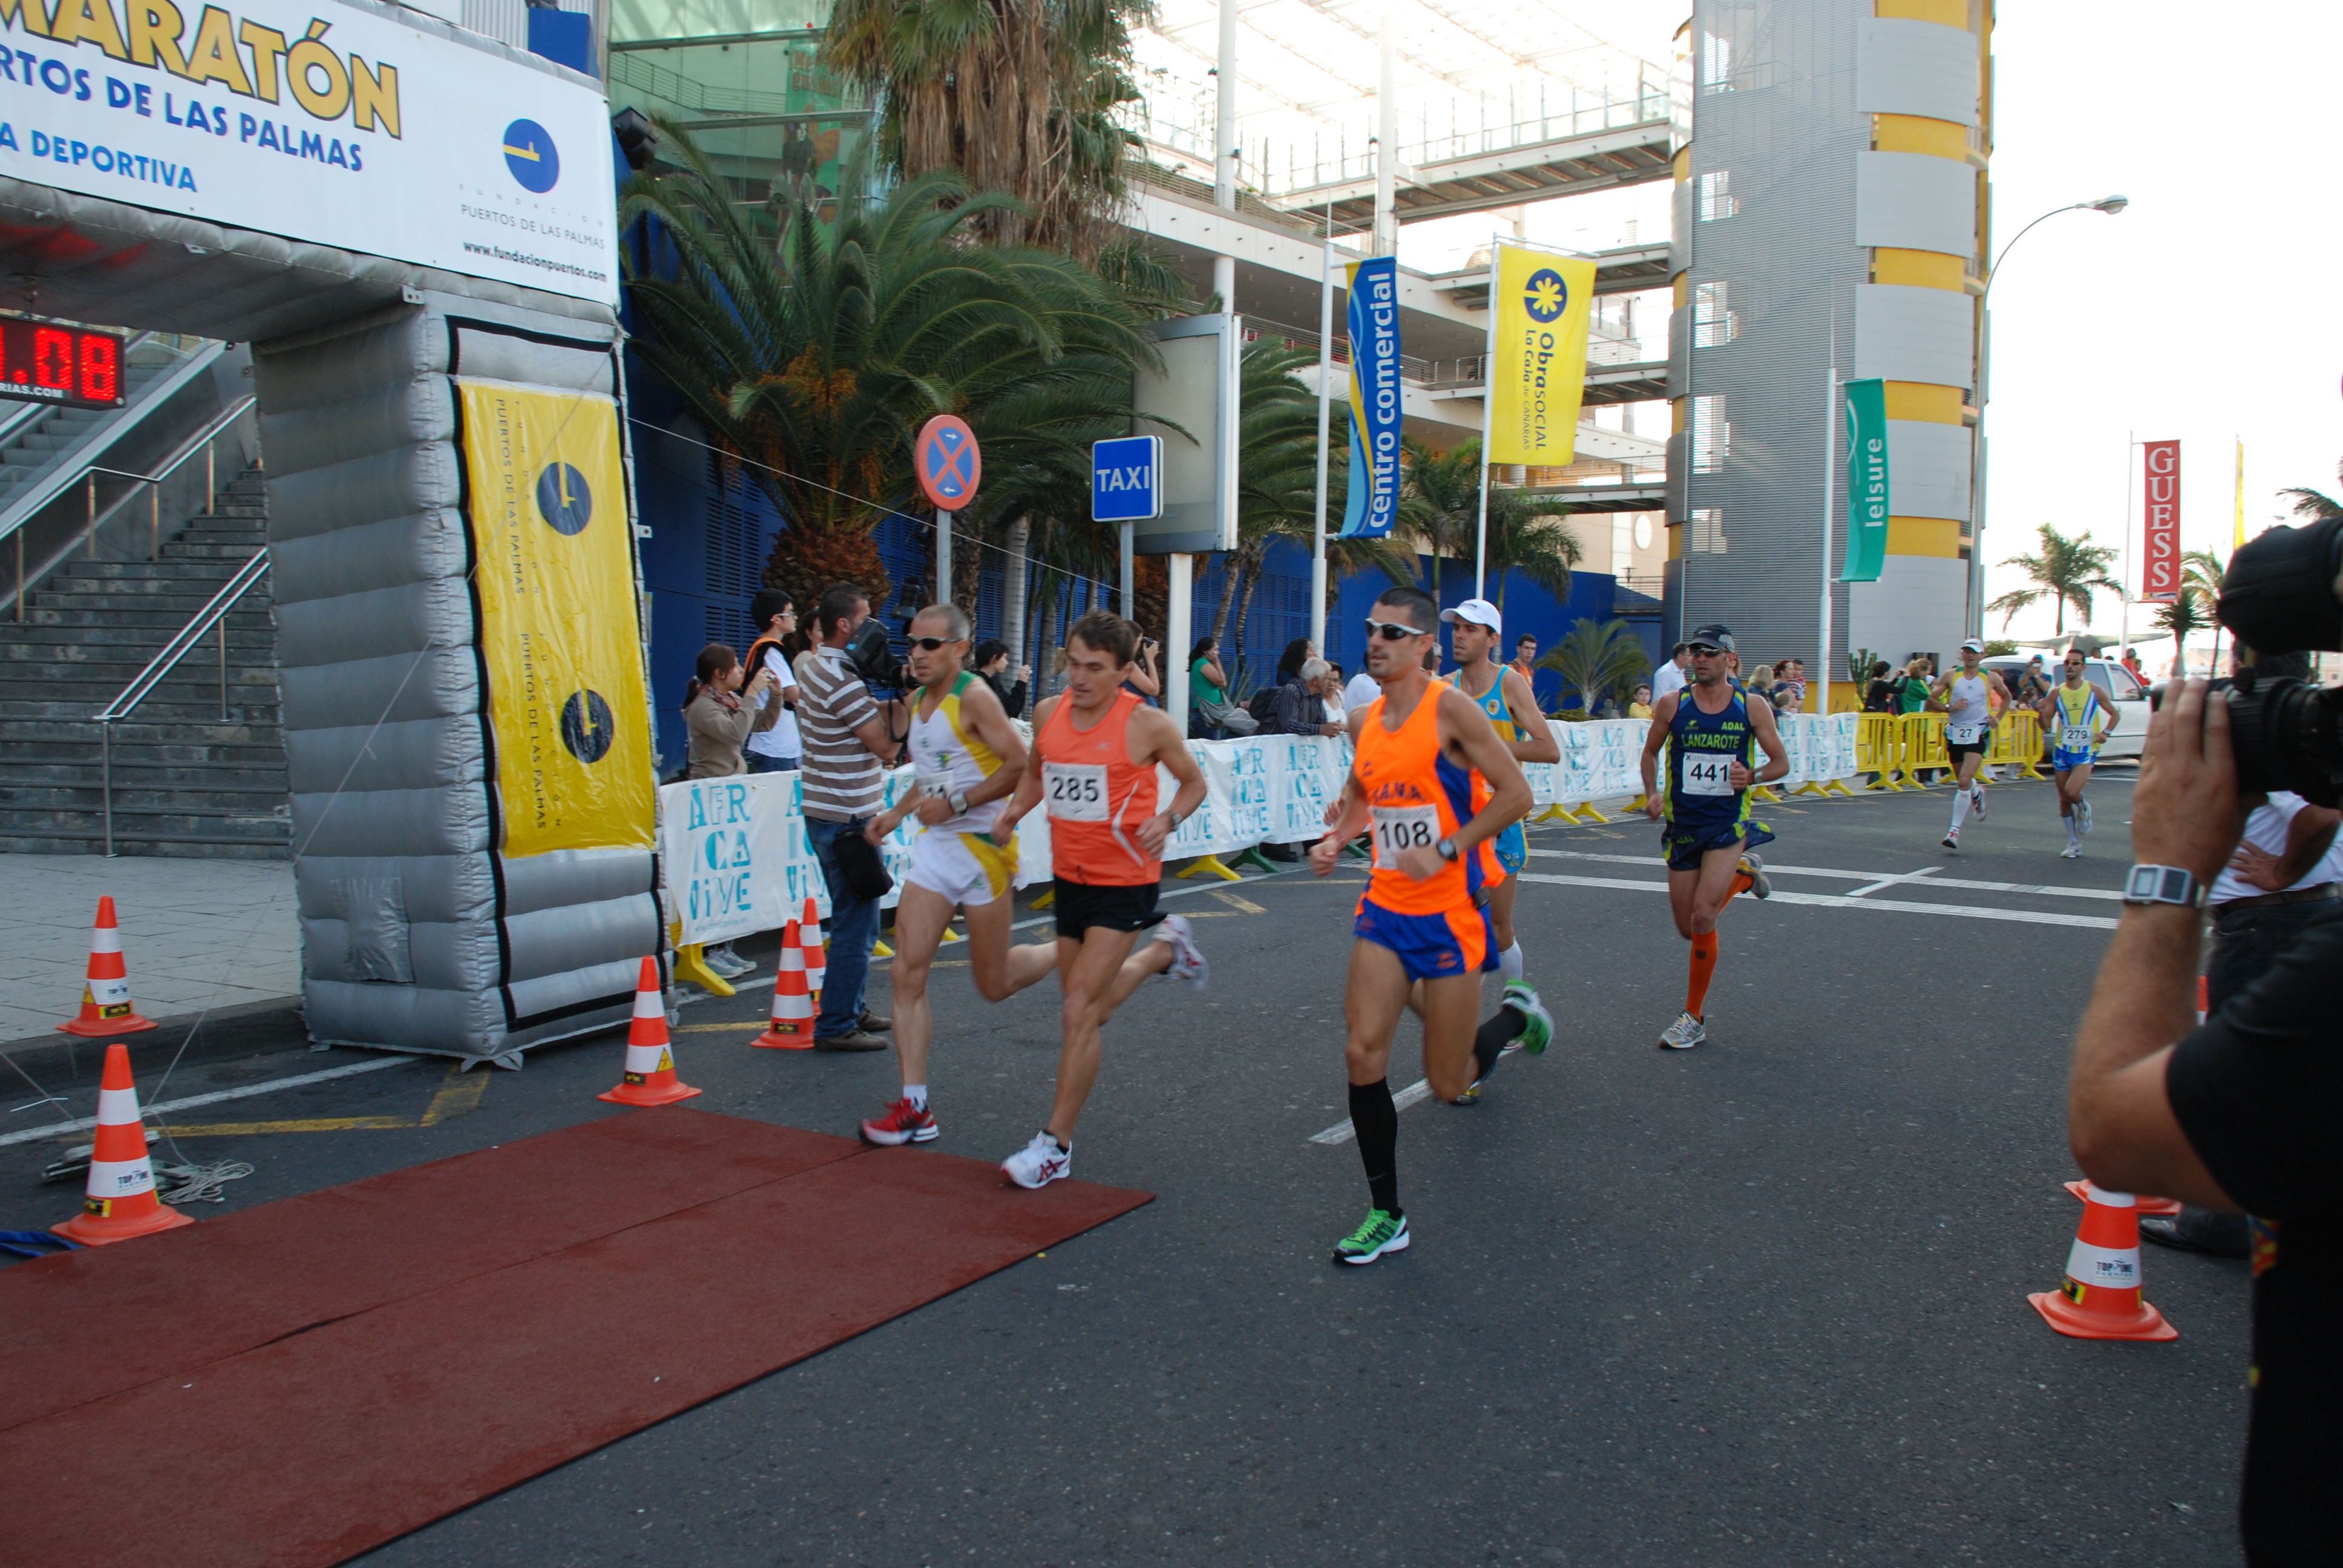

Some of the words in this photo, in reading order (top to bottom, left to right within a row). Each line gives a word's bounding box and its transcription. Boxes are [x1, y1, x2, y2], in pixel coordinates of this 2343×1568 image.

[106, 75, 152, 118] DE
[165, 92, 228, 136] LAS
[240, 112, 364, 172] PALMAS
[31, 129, 198, 193] DEPORTIVA
[460, 203, 517, 227] PUERTOS
[520, 218, 536, 232] DE
[540, 223, 562, 238] LAS
[564, 229, 605, 250] PALMAS
[462, 241, 608, 283] www.fundacionpuertos.com
[1368, 272, 1395, 425] comercial
[1525, 329, 1537, 345] La
[0, 326, 116, 400] .08
[1523, 350, 1534, 382] Caja
[1522, 385, 1530, 397] de
[496, 399, 512, 466] PUERTOS
[1522, 400, 1531, 451] CANARIAS
[504, 474, 515, 494] DE
[1096, 465, 1150, 492] TAXI
[1370, 433, 1395, 528] centro
[1864, 437, 1884, 528] leisure
[506, 501, 518, 527] LAS
[2148, 446, 2175, 587] GUESS
[510, 535, 525, 593] PALMAS
[520, 633, 536, 701] PUERTOS
[528, 708, 539, 728] DE
[1721, 721, 1745, 731] ADAL
[1959, 728, 1972, 737] 27
[2066, 729, 2088, 739] 279
[531, 736, 542, 762] LAS
[1682, 733, 1740, 749] LANZAROTE
[1690, 762, 1729, 782] 441
[533, 769, 546, 828] PALMAS
[1050, 776, 1100, 802] 285
[1379, 820, 1432, 850] 108
